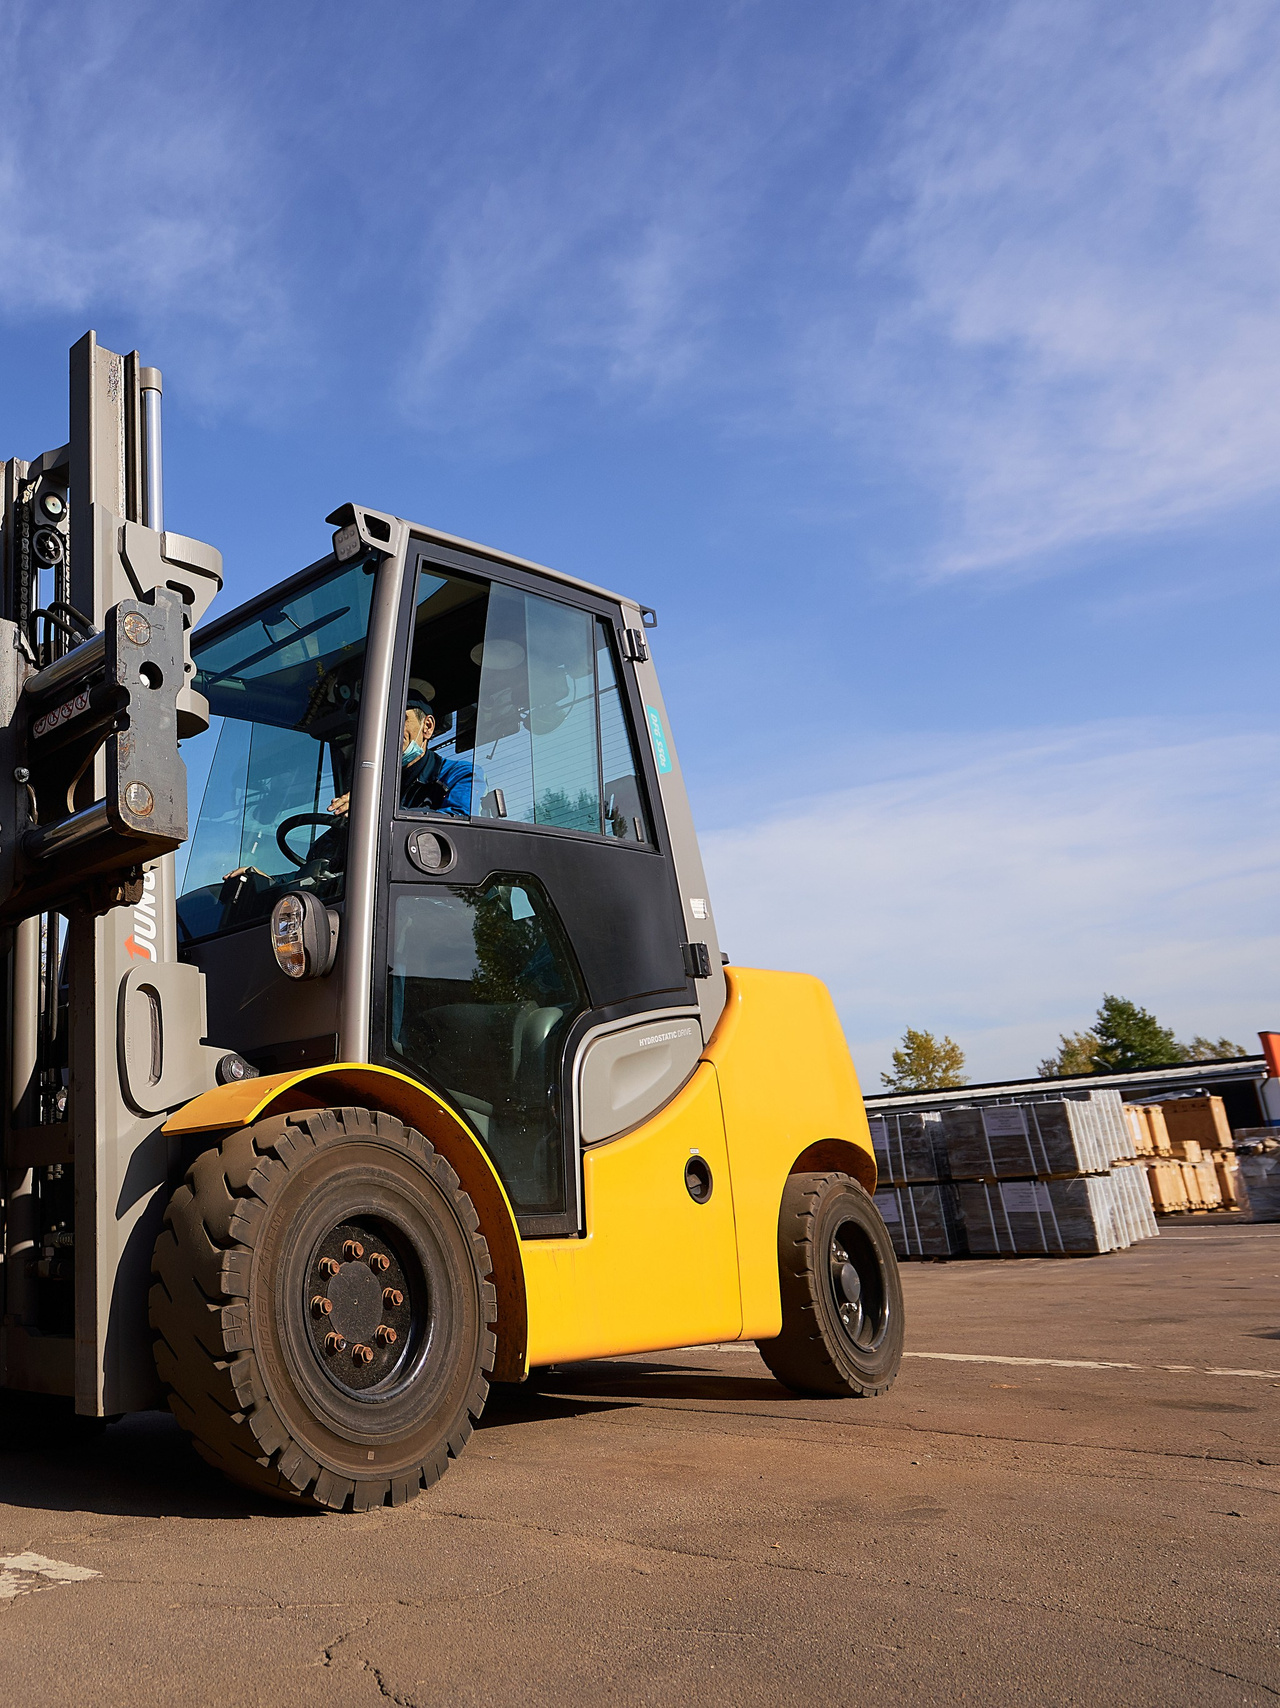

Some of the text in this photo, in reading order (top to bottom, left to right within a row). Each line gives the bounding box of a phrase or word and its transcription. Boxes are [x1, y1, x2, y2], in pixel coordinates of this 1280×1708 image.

[650, 713, 661, 737] DFG
[639, 1028, 692, 1046] HYDROSTATIC DRIVE
